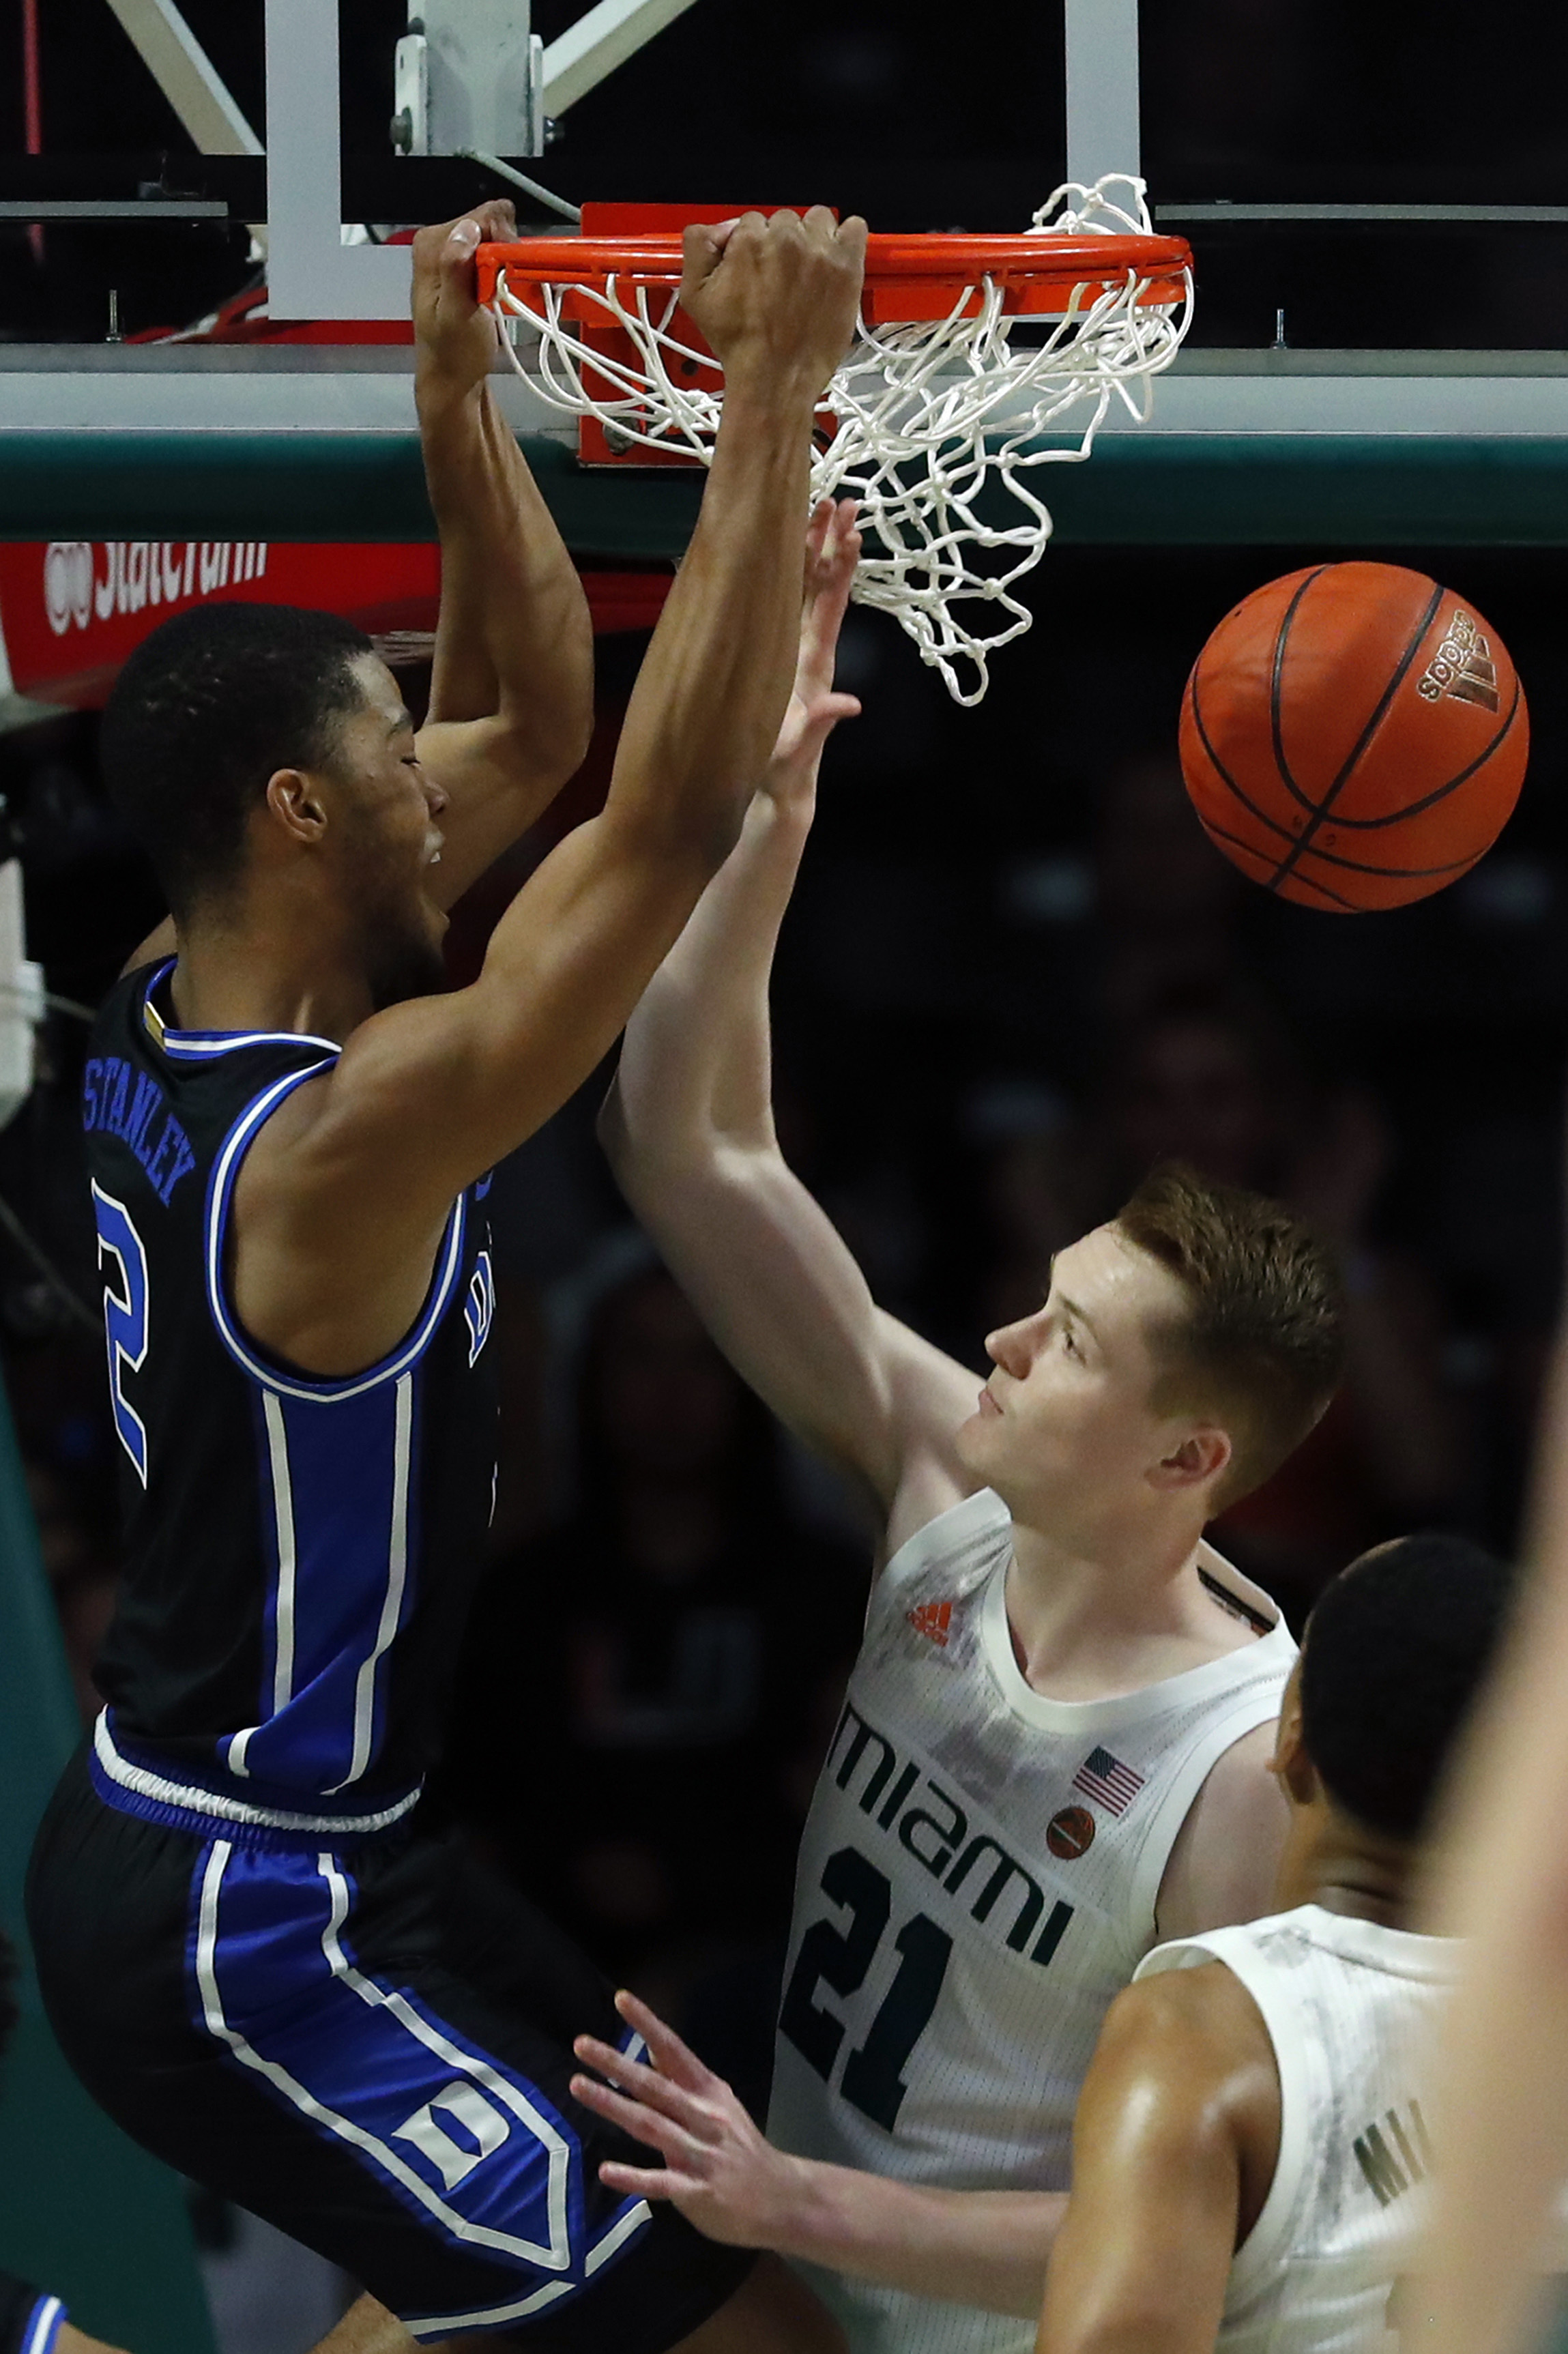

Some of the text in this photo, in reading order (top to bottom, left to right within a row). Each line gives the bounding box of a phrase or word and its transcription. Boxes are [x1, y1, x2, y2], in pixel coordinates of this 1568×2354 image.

[83, 1056, 195, 1208] STANLEY
[90, 1176, 149, 1491] 2
[779, 1846, 954, 2134] 21
[391, 2080, 510, 2192] D
[1353, 2098, 1433, 2208] MI
